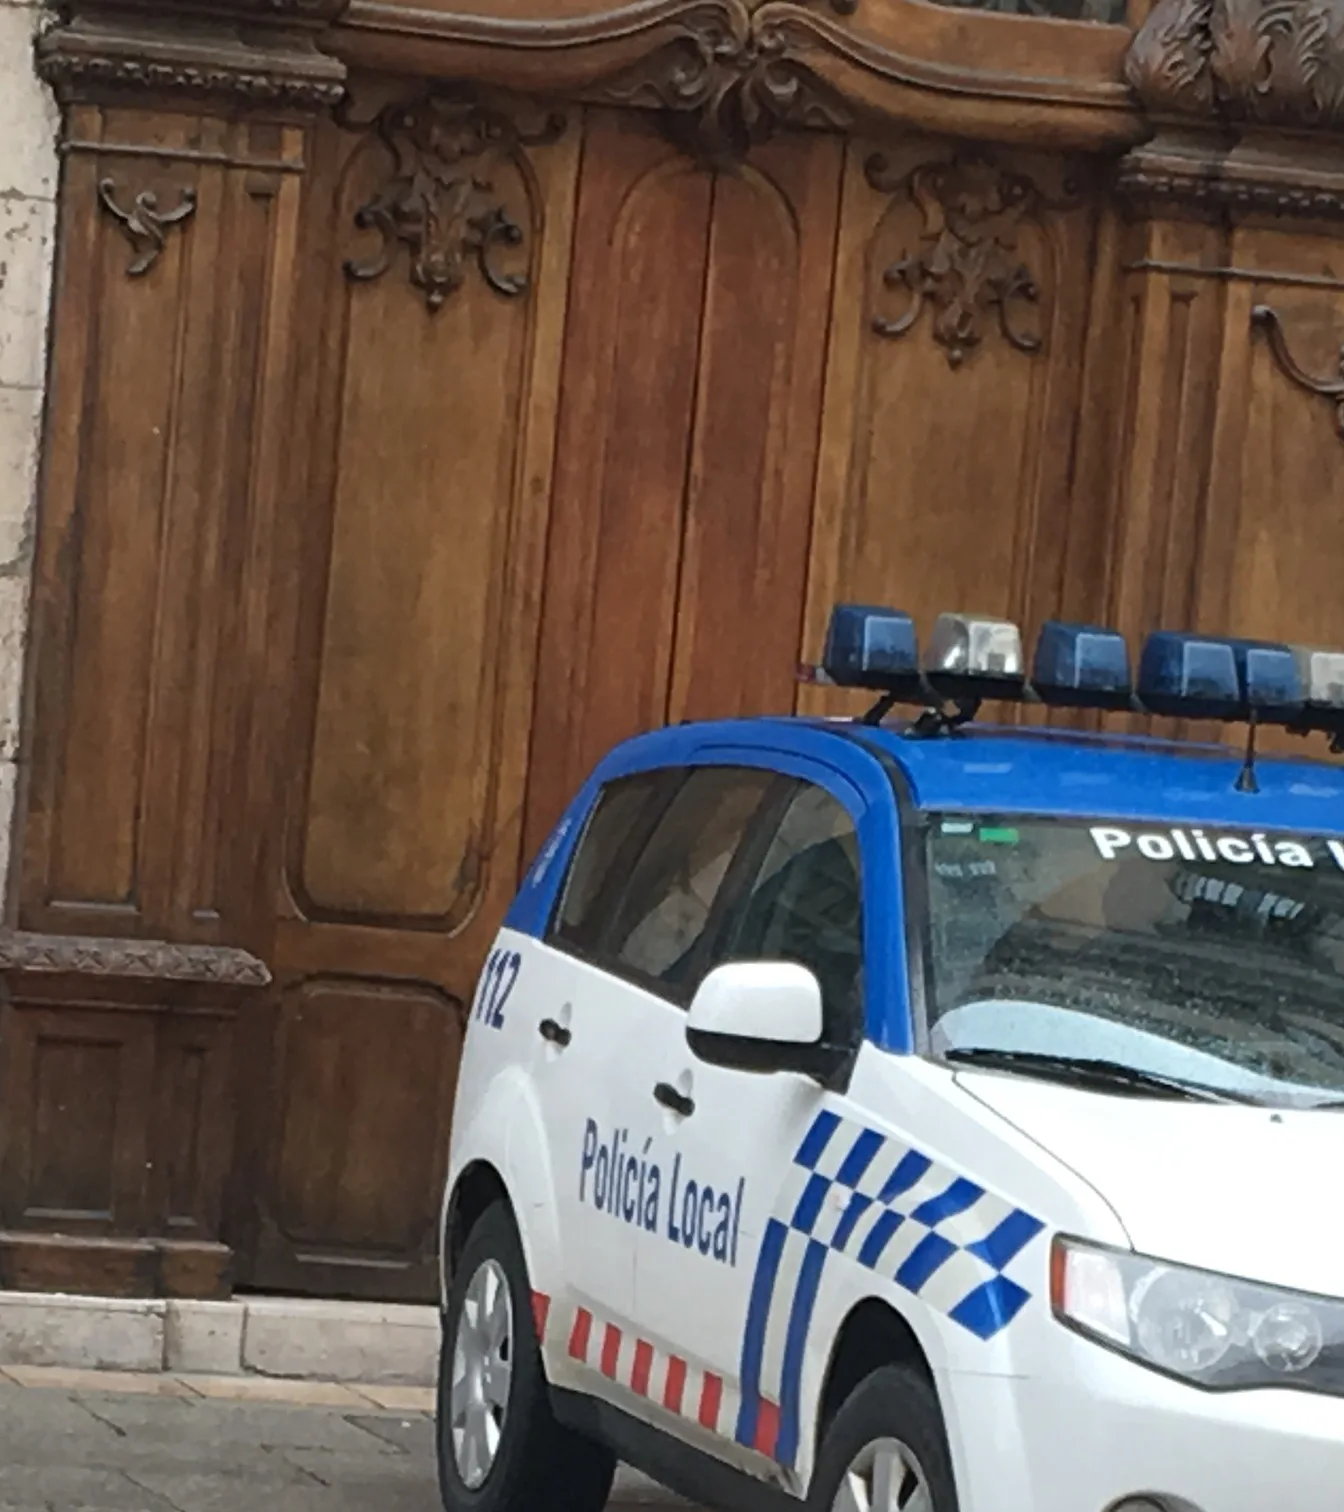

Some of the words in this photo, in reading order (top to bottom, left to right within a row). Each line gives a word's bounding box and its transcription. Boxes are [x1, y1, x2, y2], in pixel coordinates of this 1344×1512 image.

[1090, 827, 1314, 867] Policía
[475, 949, 521, 1030] 112
[579, 1117, 660, 1233] Policía
[668, 1152, 747, 1267] Local
